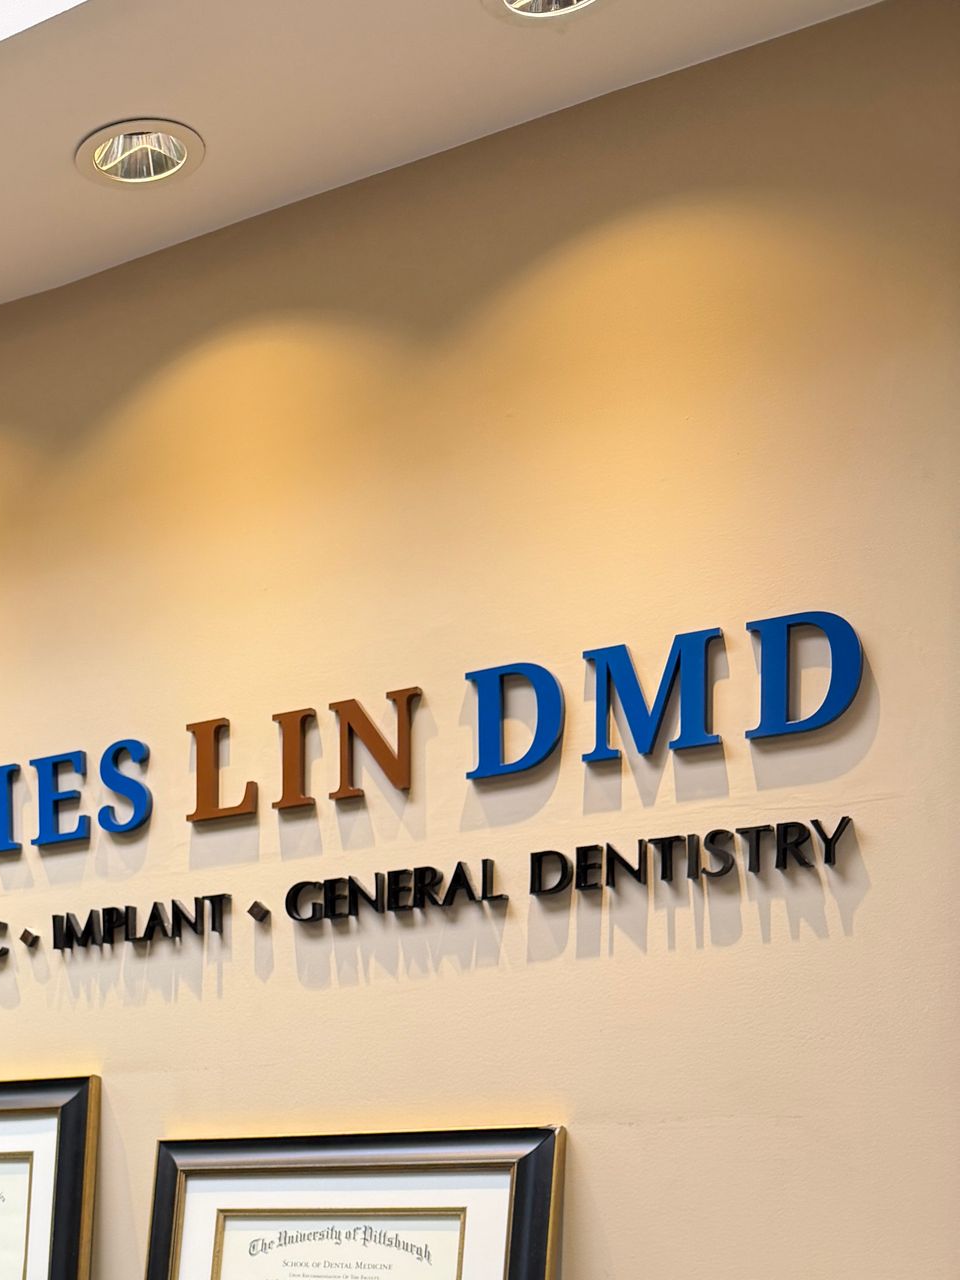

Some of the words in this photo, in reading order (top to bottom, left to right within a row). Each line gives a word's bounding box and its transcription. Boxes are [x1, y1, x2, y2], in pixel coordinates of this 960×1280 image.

[186, 686, 423, 822] LIN
[465, 611, 863, 780] DMD
[52, 892, 232, 951] IMPLANT
[285, 858, 510, 923] GENERAL
[530, 815, 852, 896] DENTISTRY
[248, 1237, 275, 1257] The
[276, 1225, 342, 1248] University
[344, 1225, 362, 1241] of
[359, 1224, 433, 1267] Pittsburgh
[323, 1260, 353, 1270] DENTAL
[355, 1261, 393, 1271] MEDICINE
